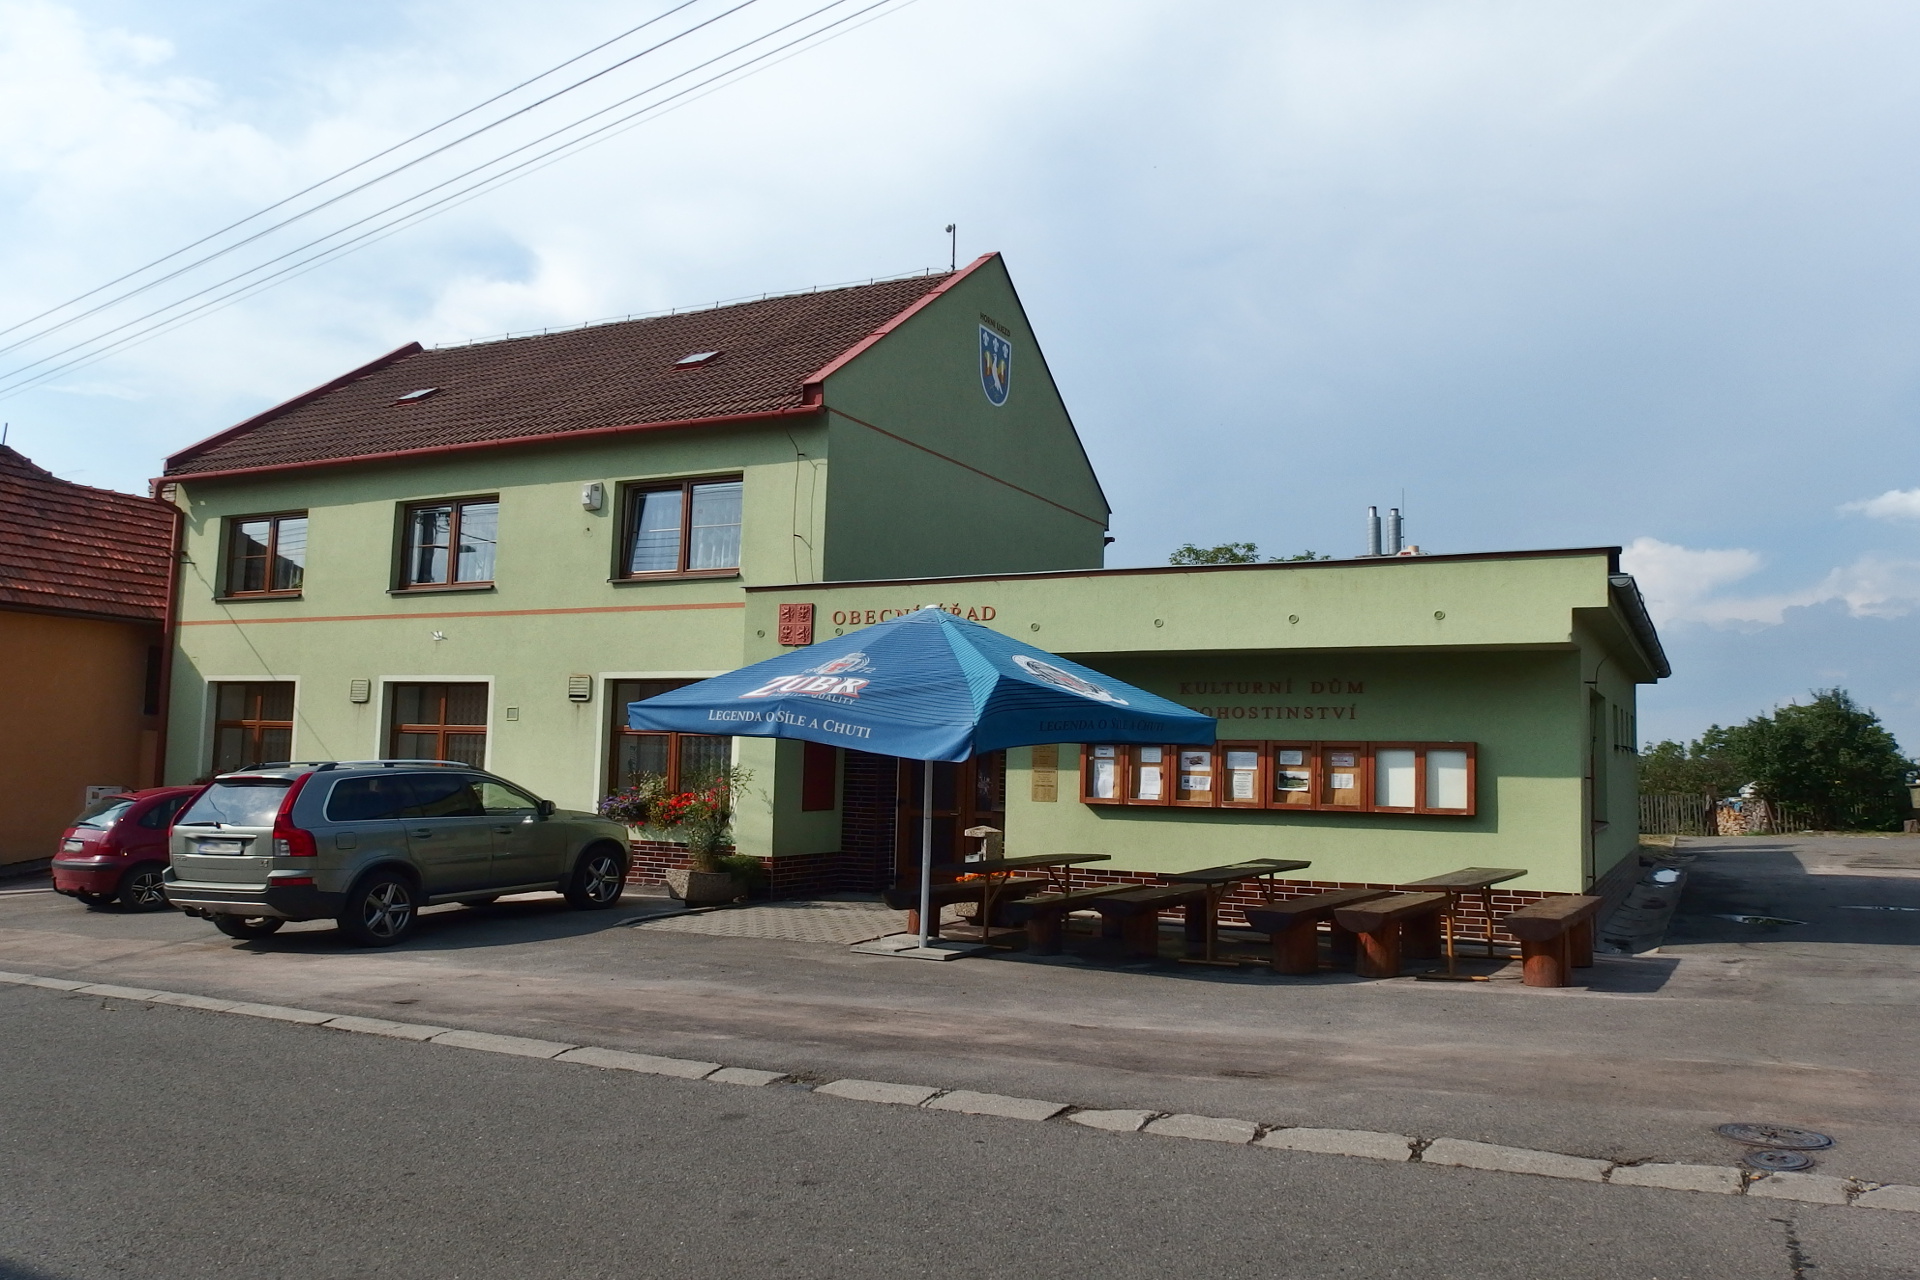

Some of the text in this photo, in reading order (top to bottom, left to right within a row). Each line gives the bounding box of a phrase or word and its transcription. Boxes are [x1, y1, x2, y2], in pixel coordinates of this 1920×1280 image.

[832, 603, 996, 625] OBECN ŘAD
[738, 673, 870, 699] ZUBR
[1179, 678, 1364, 695] KULTURNÍ DŮM
[811, 693, 856, 706] QUALITY
[708, 709, 872, 739] LEGENDA O SÍLE A CHUTI
[1038, 719, 1095, 732] LEGENDA
[1098, 719, 1108, 730] O
